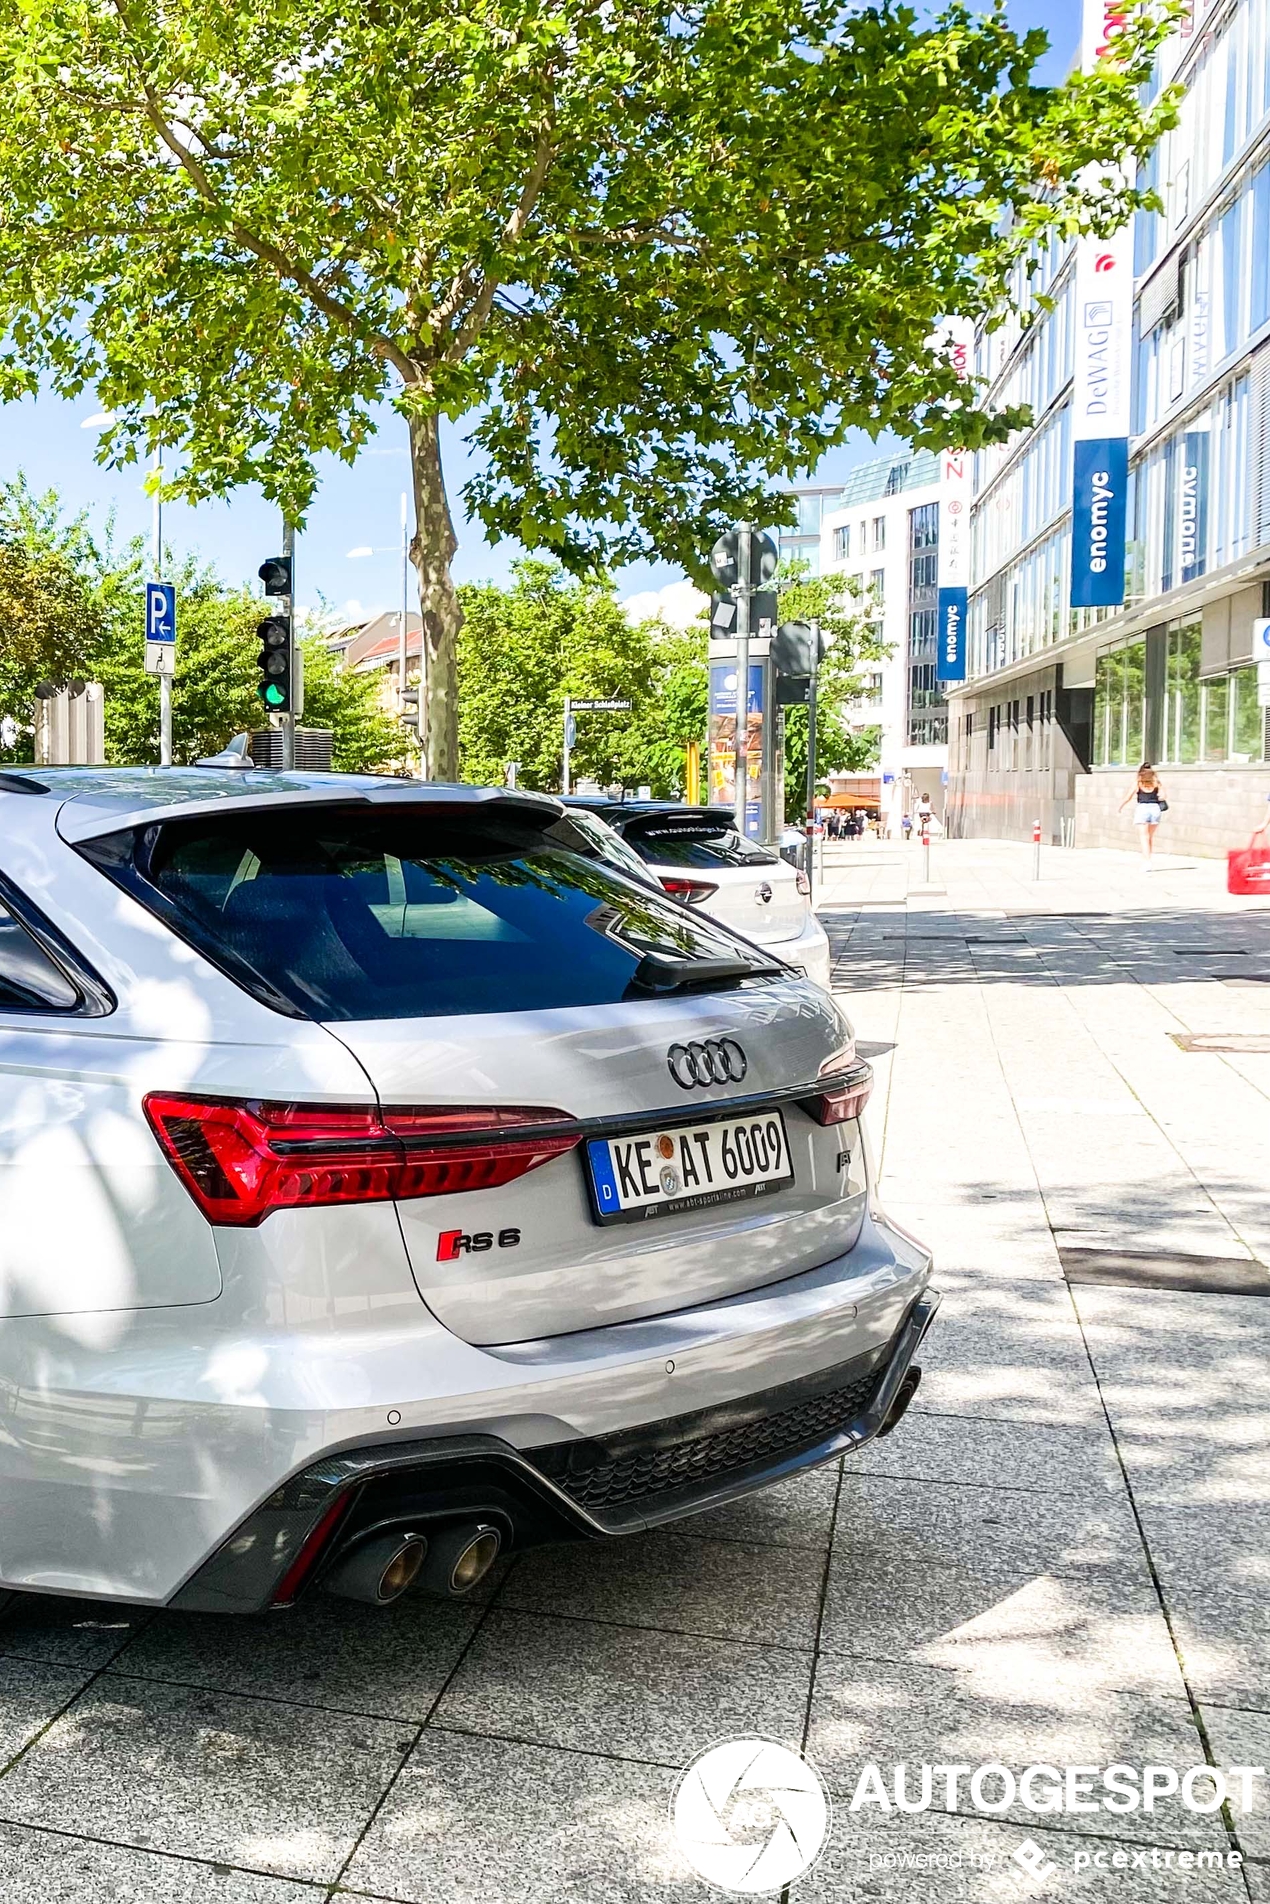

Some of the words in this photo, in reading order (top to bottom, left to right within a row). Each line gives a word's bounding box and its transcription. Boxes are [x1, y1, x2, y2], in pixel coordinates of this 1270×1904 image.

[1086, 330, 1109, 416] DeWAG
[1090, 471, 1114, 573] enomyc
[150, 590, 167, 634] P
[946, 604, 961, 663] enomyc
[614, 1140, 661, 1199] KE
[679, 1131, 714, 1188] AT
[721, 1120, 781, 1180] 6009
[602, 1184, 612, 1200] D
[668, 1188, 747, 1211] www.abt-sportsline.com
[754, 1183, 766, 1195] ABT
[644, 1204, 659, 1218] ABT
[498, 1227, 521, 1248] 6
